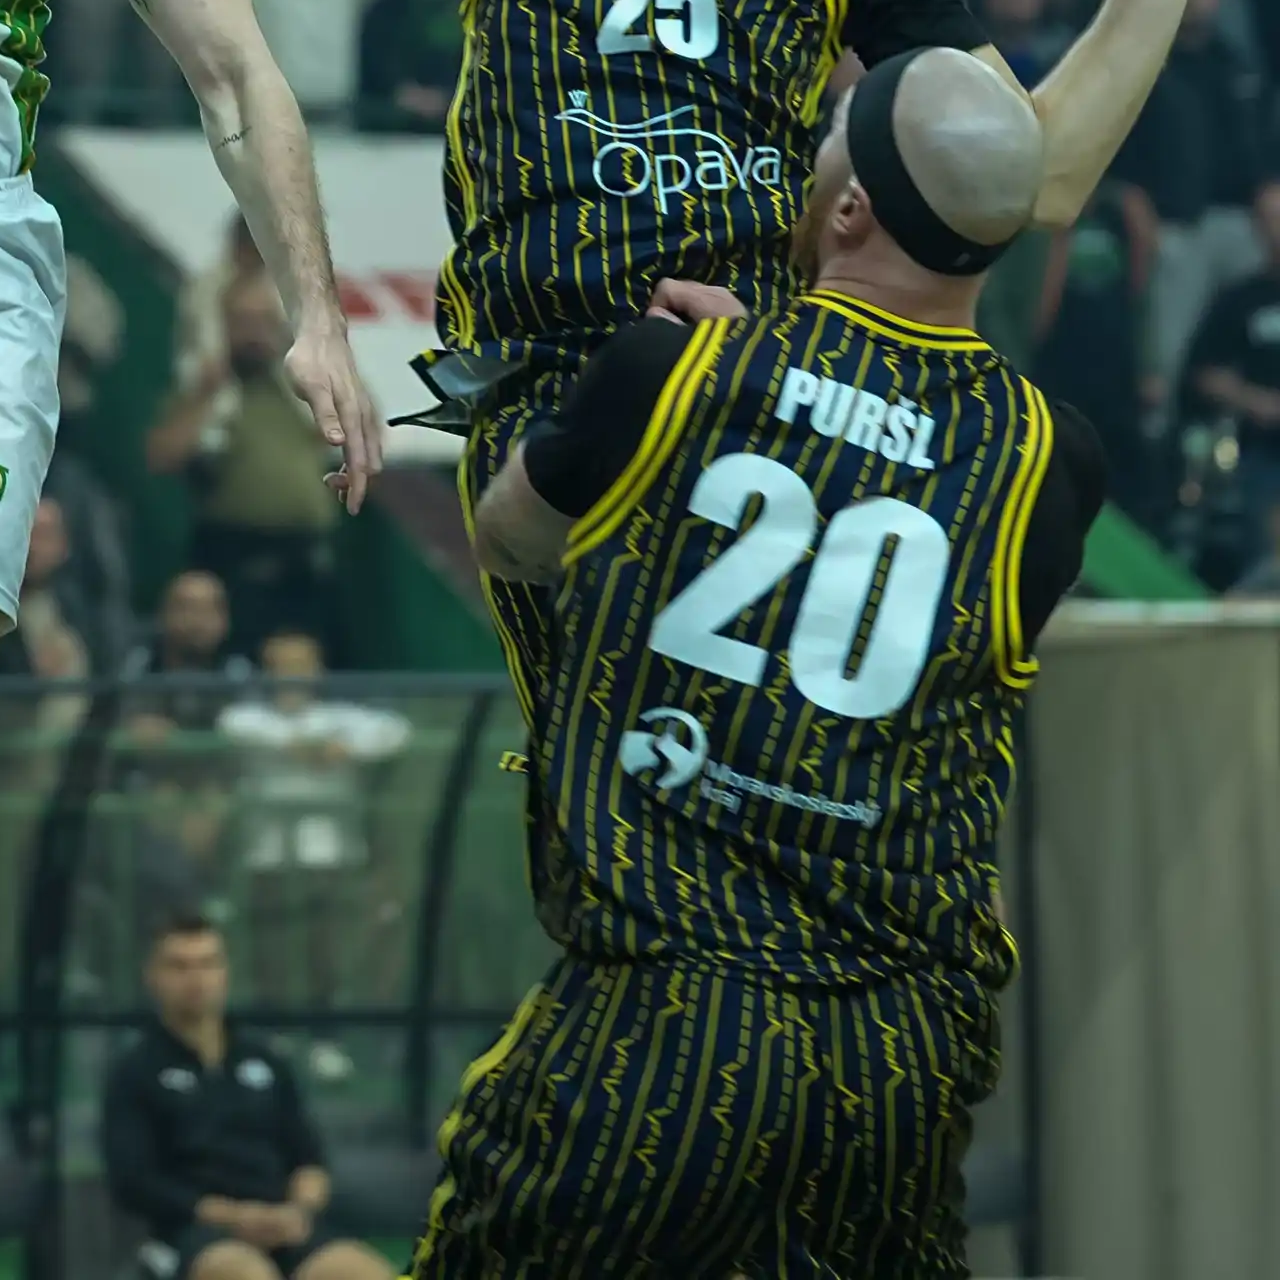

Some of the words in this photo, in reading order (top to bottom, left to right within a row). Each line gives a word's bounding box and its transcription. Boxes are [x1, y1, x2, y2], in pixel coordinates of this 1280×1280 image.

[592, 141, 782, 215] Opava
[774, 366, 935, 470] PURŠL
[647, 452, 950, 719] 20
